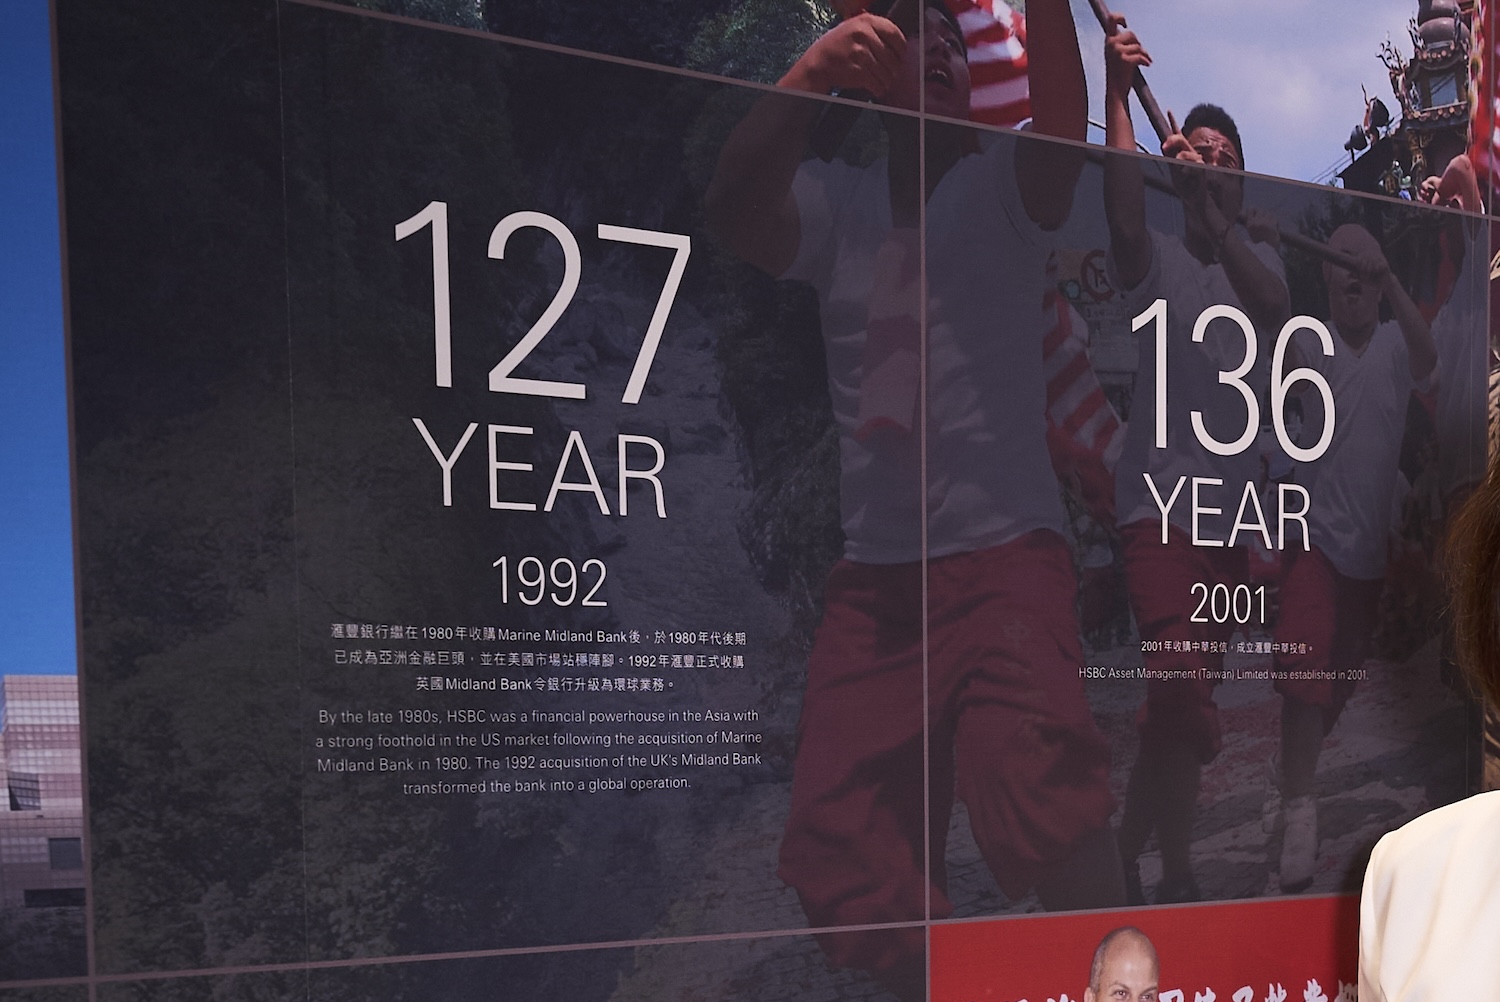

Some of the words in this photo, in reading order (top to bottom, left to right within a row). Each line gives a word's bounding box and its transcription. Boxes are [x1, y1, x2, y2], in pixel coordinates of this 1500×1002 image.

[395, 200, 691, 404] 127
[1131, 298, 1336, 463] 136
[412, 417, 668, 518] YEAR
[1142, 472, 1311, 552] YEAR
[493, 556, 607, 606] 1992
[1190, 582, 1266, 624] 2001
[545, 630, 592, 642] Midland
[1079, 667, 1106, 678] HSBC
[1107, 668, 1136, 678] Asset
[1137, 668, 1196, 681] Management
[1198, 668, 1234, 680] (Taiwan)
[1237, 669, 1268, 679] Limited
[1290, 669, 1336, 680] established
[1347, 669, 1368, 680] 2001.
[319, 710, 336, 725] By
[341, 710, 363, 723] the
[368, 710, 392, 723] late
[399, 710, 442, 724] 1980s,
[448, 710, 486, 723] HSBC
[490, 713, 516, 722] was
[521, 713, 527, 722] a
[532, 710, 585, 722] financial
[589, 710, 665, 724] powerhouse
[669, 710, 679, 721] in
[683, 710, 701, 721] the
[705, 710, 730, 721] Asia
[733, 710, 758, 721] with
[316, 738, 323, 747] a
[328, 737, 373, 750] strong
[378, 734, 435, 747] foothold
[440, 734, 451, 746] in
[456, 734, 476, 746] the
[481, 733, 500, 746] US
[505, 733, 549, 745] market
[553, 733, 611, 747] following
[615, 732, 634, 744] the
[638, 732, 703, 746] acquisition
[707, 731, 718, 743] of
[722, 731, 762, 743] Marine
[318, 759, 374, 771] Midland
[380, 758, 414, 771] Bank
[419, 761, 430, 770] in
[436, 757, 471, 770] 1980.
[475, 757, 500, 769] The
[505, 756, 535, 769] 1992
[540, 755, 608, 770] acquisition
[612, 755, 624, 767] of
[628, 755, 647, 767] the
[651, 754, 677, 766] UK's
[682, 753, 729, 765] Midland
[733, 753, 761, 765] Bank
[404, 780, 486, 794] transformed
[490, 780, 511, 792] the
[515, 779, 546, 792] bank
[551, 779, 574, 791] into
[578, 781, 584, 790] a
[589, 777, 626, 793] global
[630, 776, 691, 791] operation.
